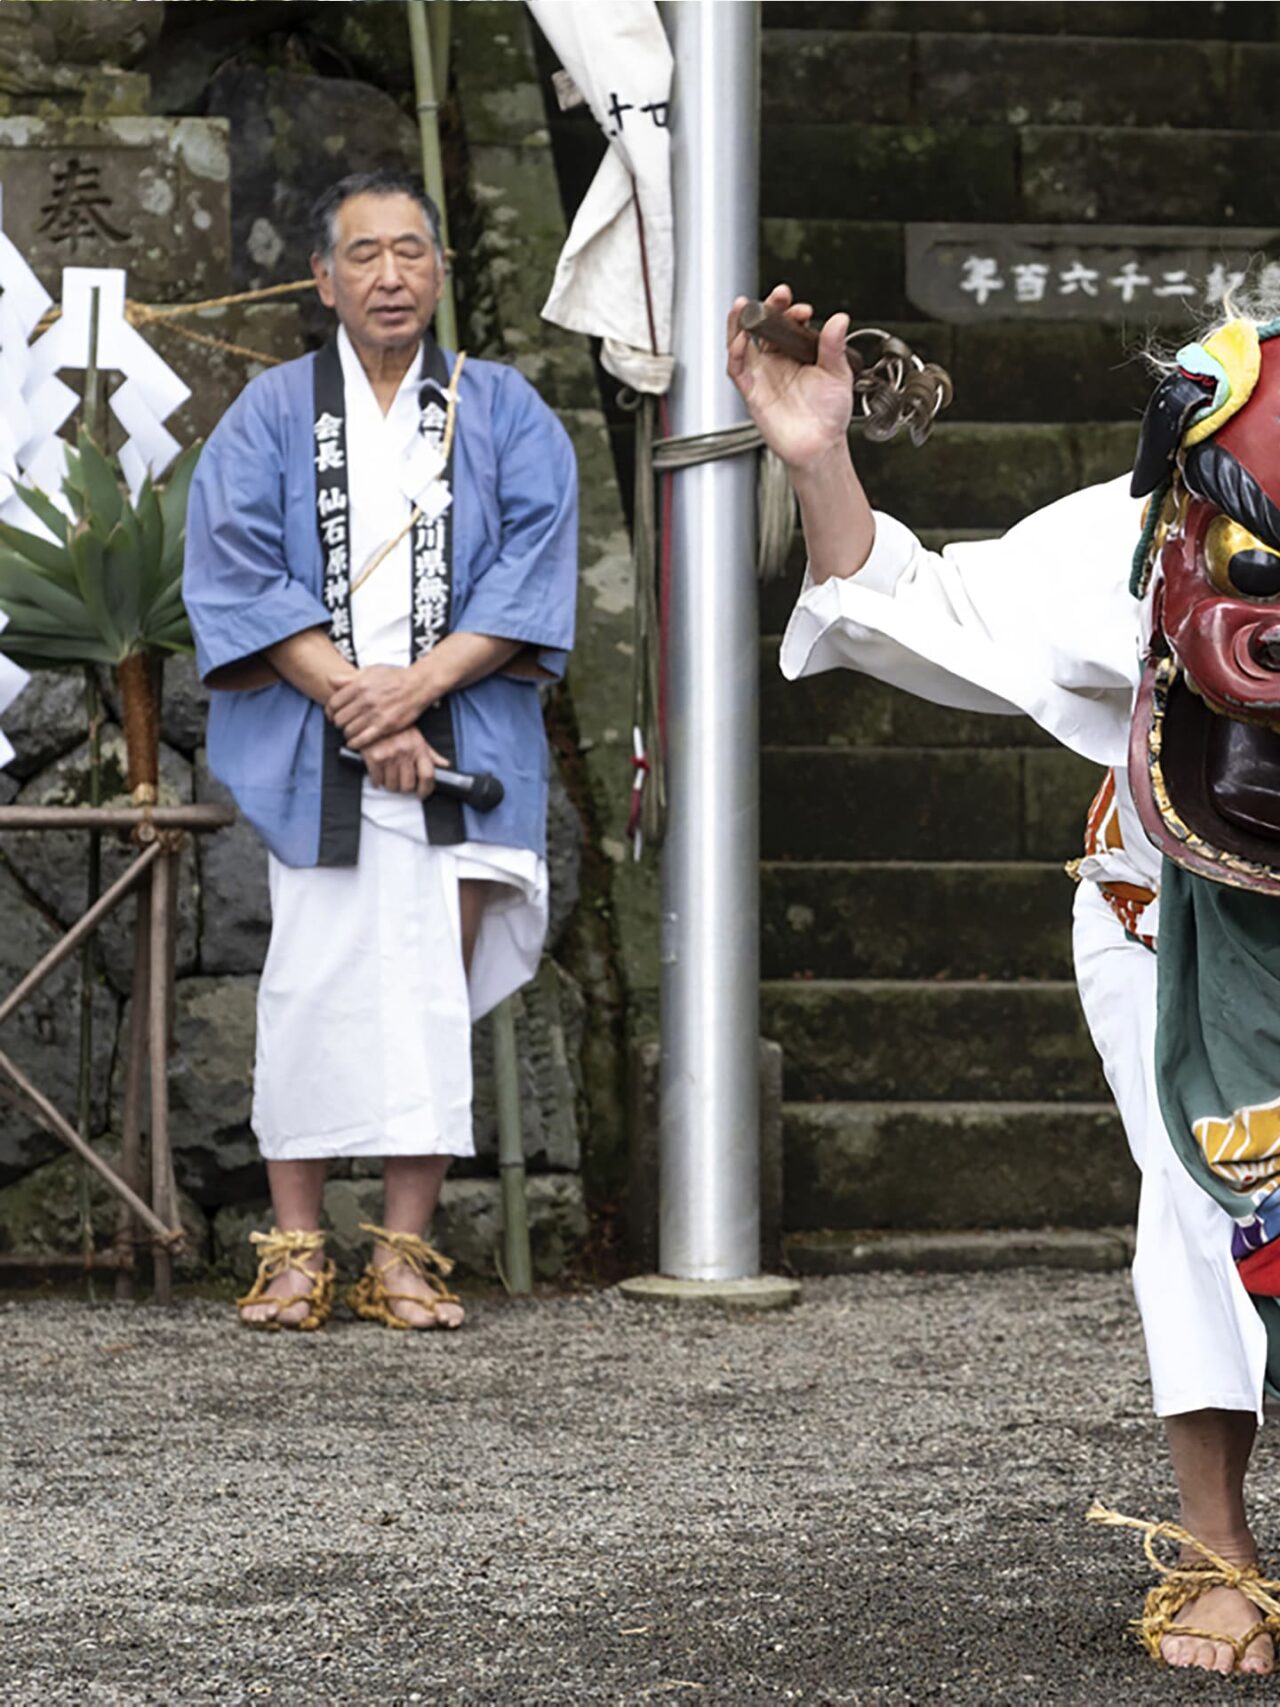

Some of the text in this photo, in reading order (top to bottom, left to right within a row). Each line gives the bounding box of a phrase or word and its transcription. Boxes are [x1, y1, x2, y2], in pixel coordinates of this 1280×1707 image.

[608, 92, 669, 136] 十七
[37, 158, 133, 253] 奉
[314, 412, 344, 472] 会長
[413, 509, 450, 655] 川県無形文
